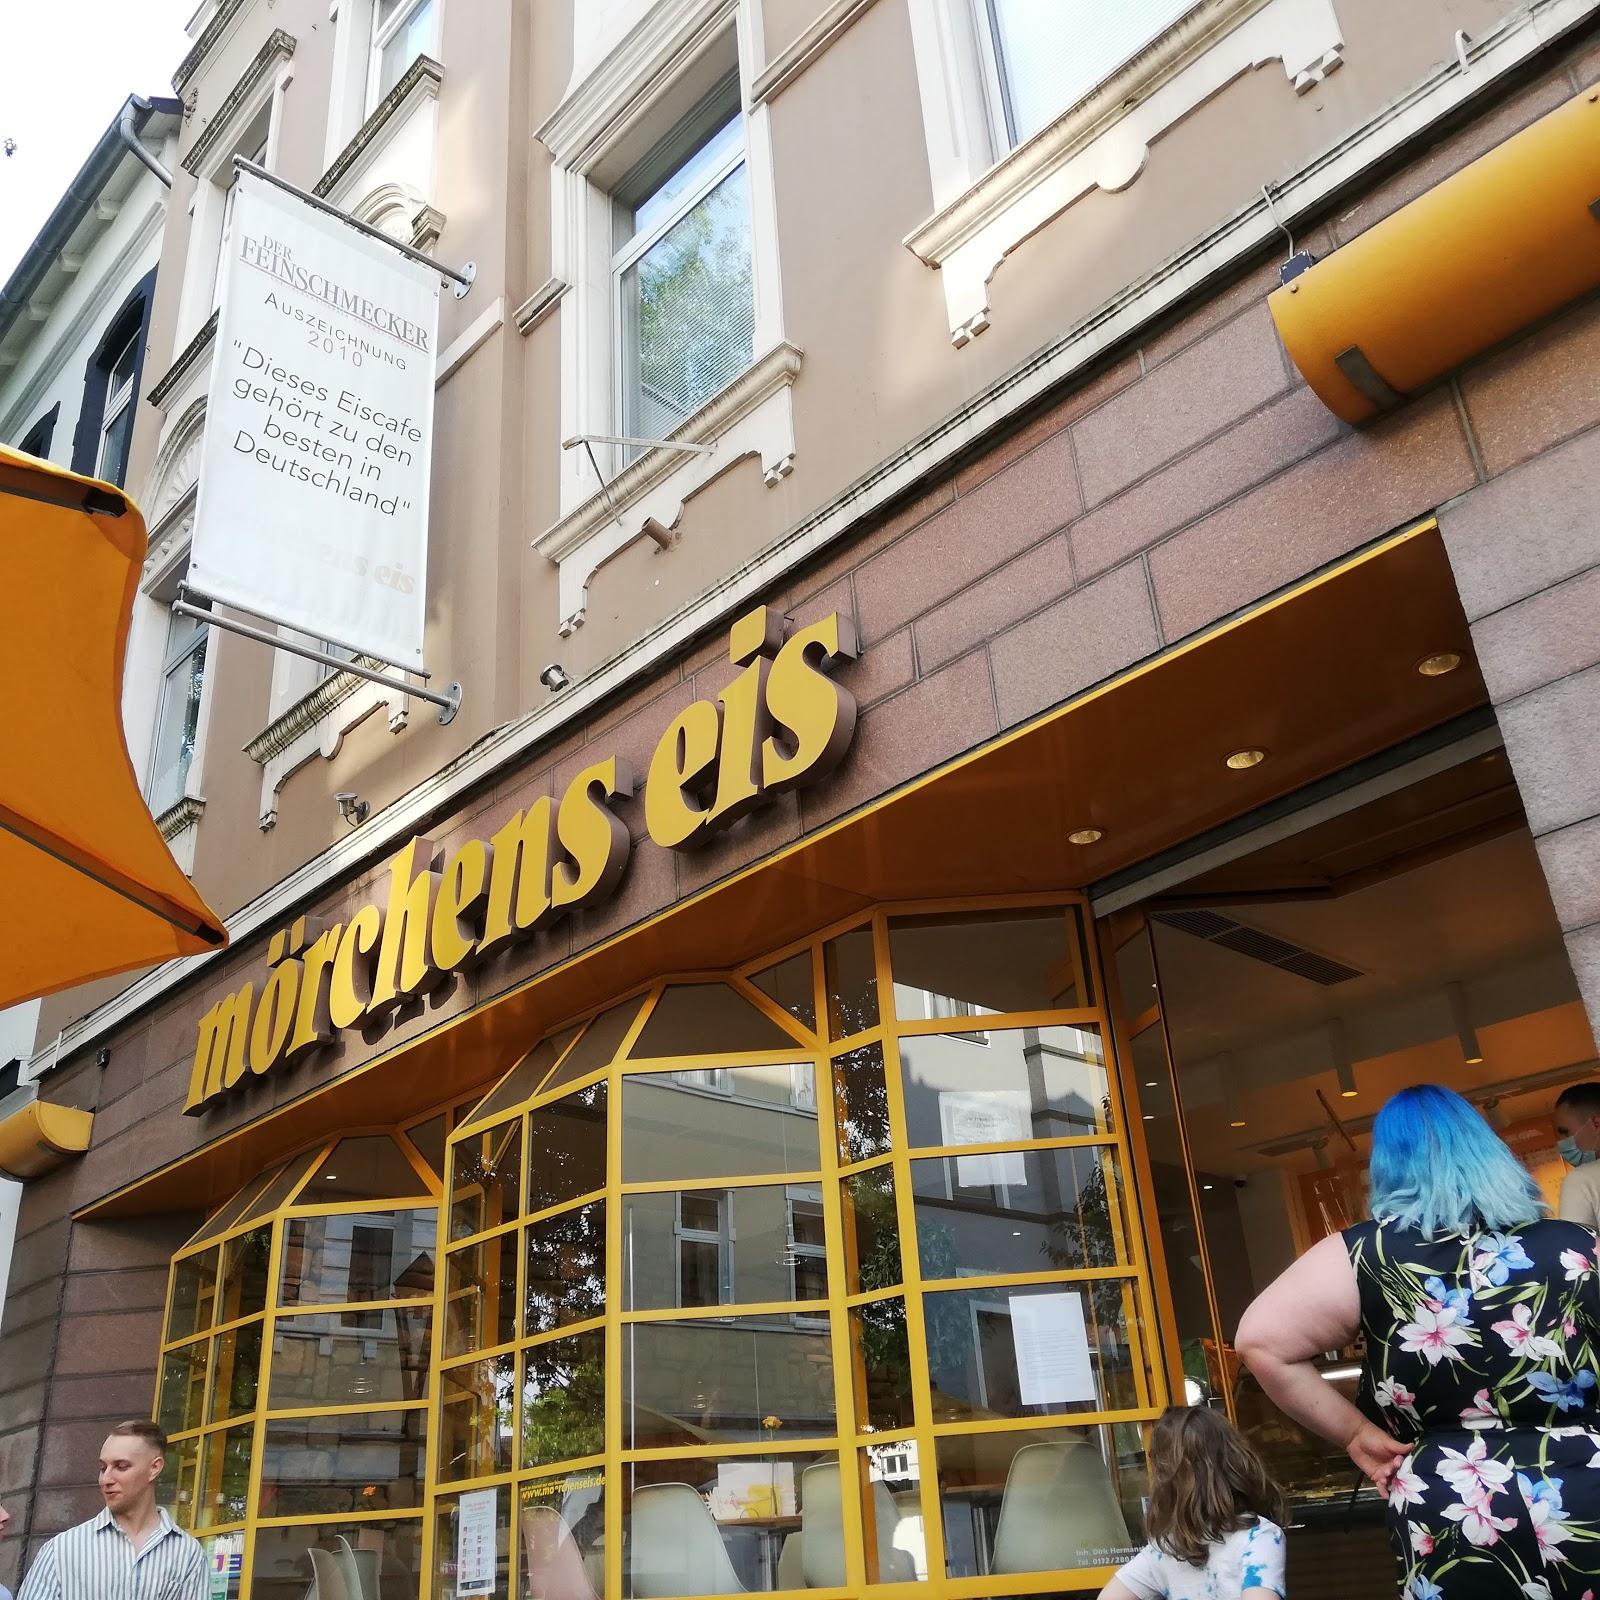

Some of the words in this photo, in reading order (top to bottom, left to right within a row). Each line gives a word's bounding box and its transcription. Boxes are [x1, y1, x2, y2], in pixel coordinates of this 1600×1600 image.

[263, 235, 293, 259] DER
[241, 234, 430, 350] FEINSCHMECKER
[233, 339, 329, 402] "Dieses
[336, 389, 422, 443] Eiscafe
[307, 330, 363, 368] 2010
[232, 377, 324, 429] gehört
[328, 420, 359, 443] zu
[365, 433, 412, 467] den
[263, 414, 353, 470] besten
[359, 456, 382, 481] in
[233, 429, 411, 516] Deutschland"
[182, 755, 626, 1117] mörchens
[643, 604, 852, 852] eis
